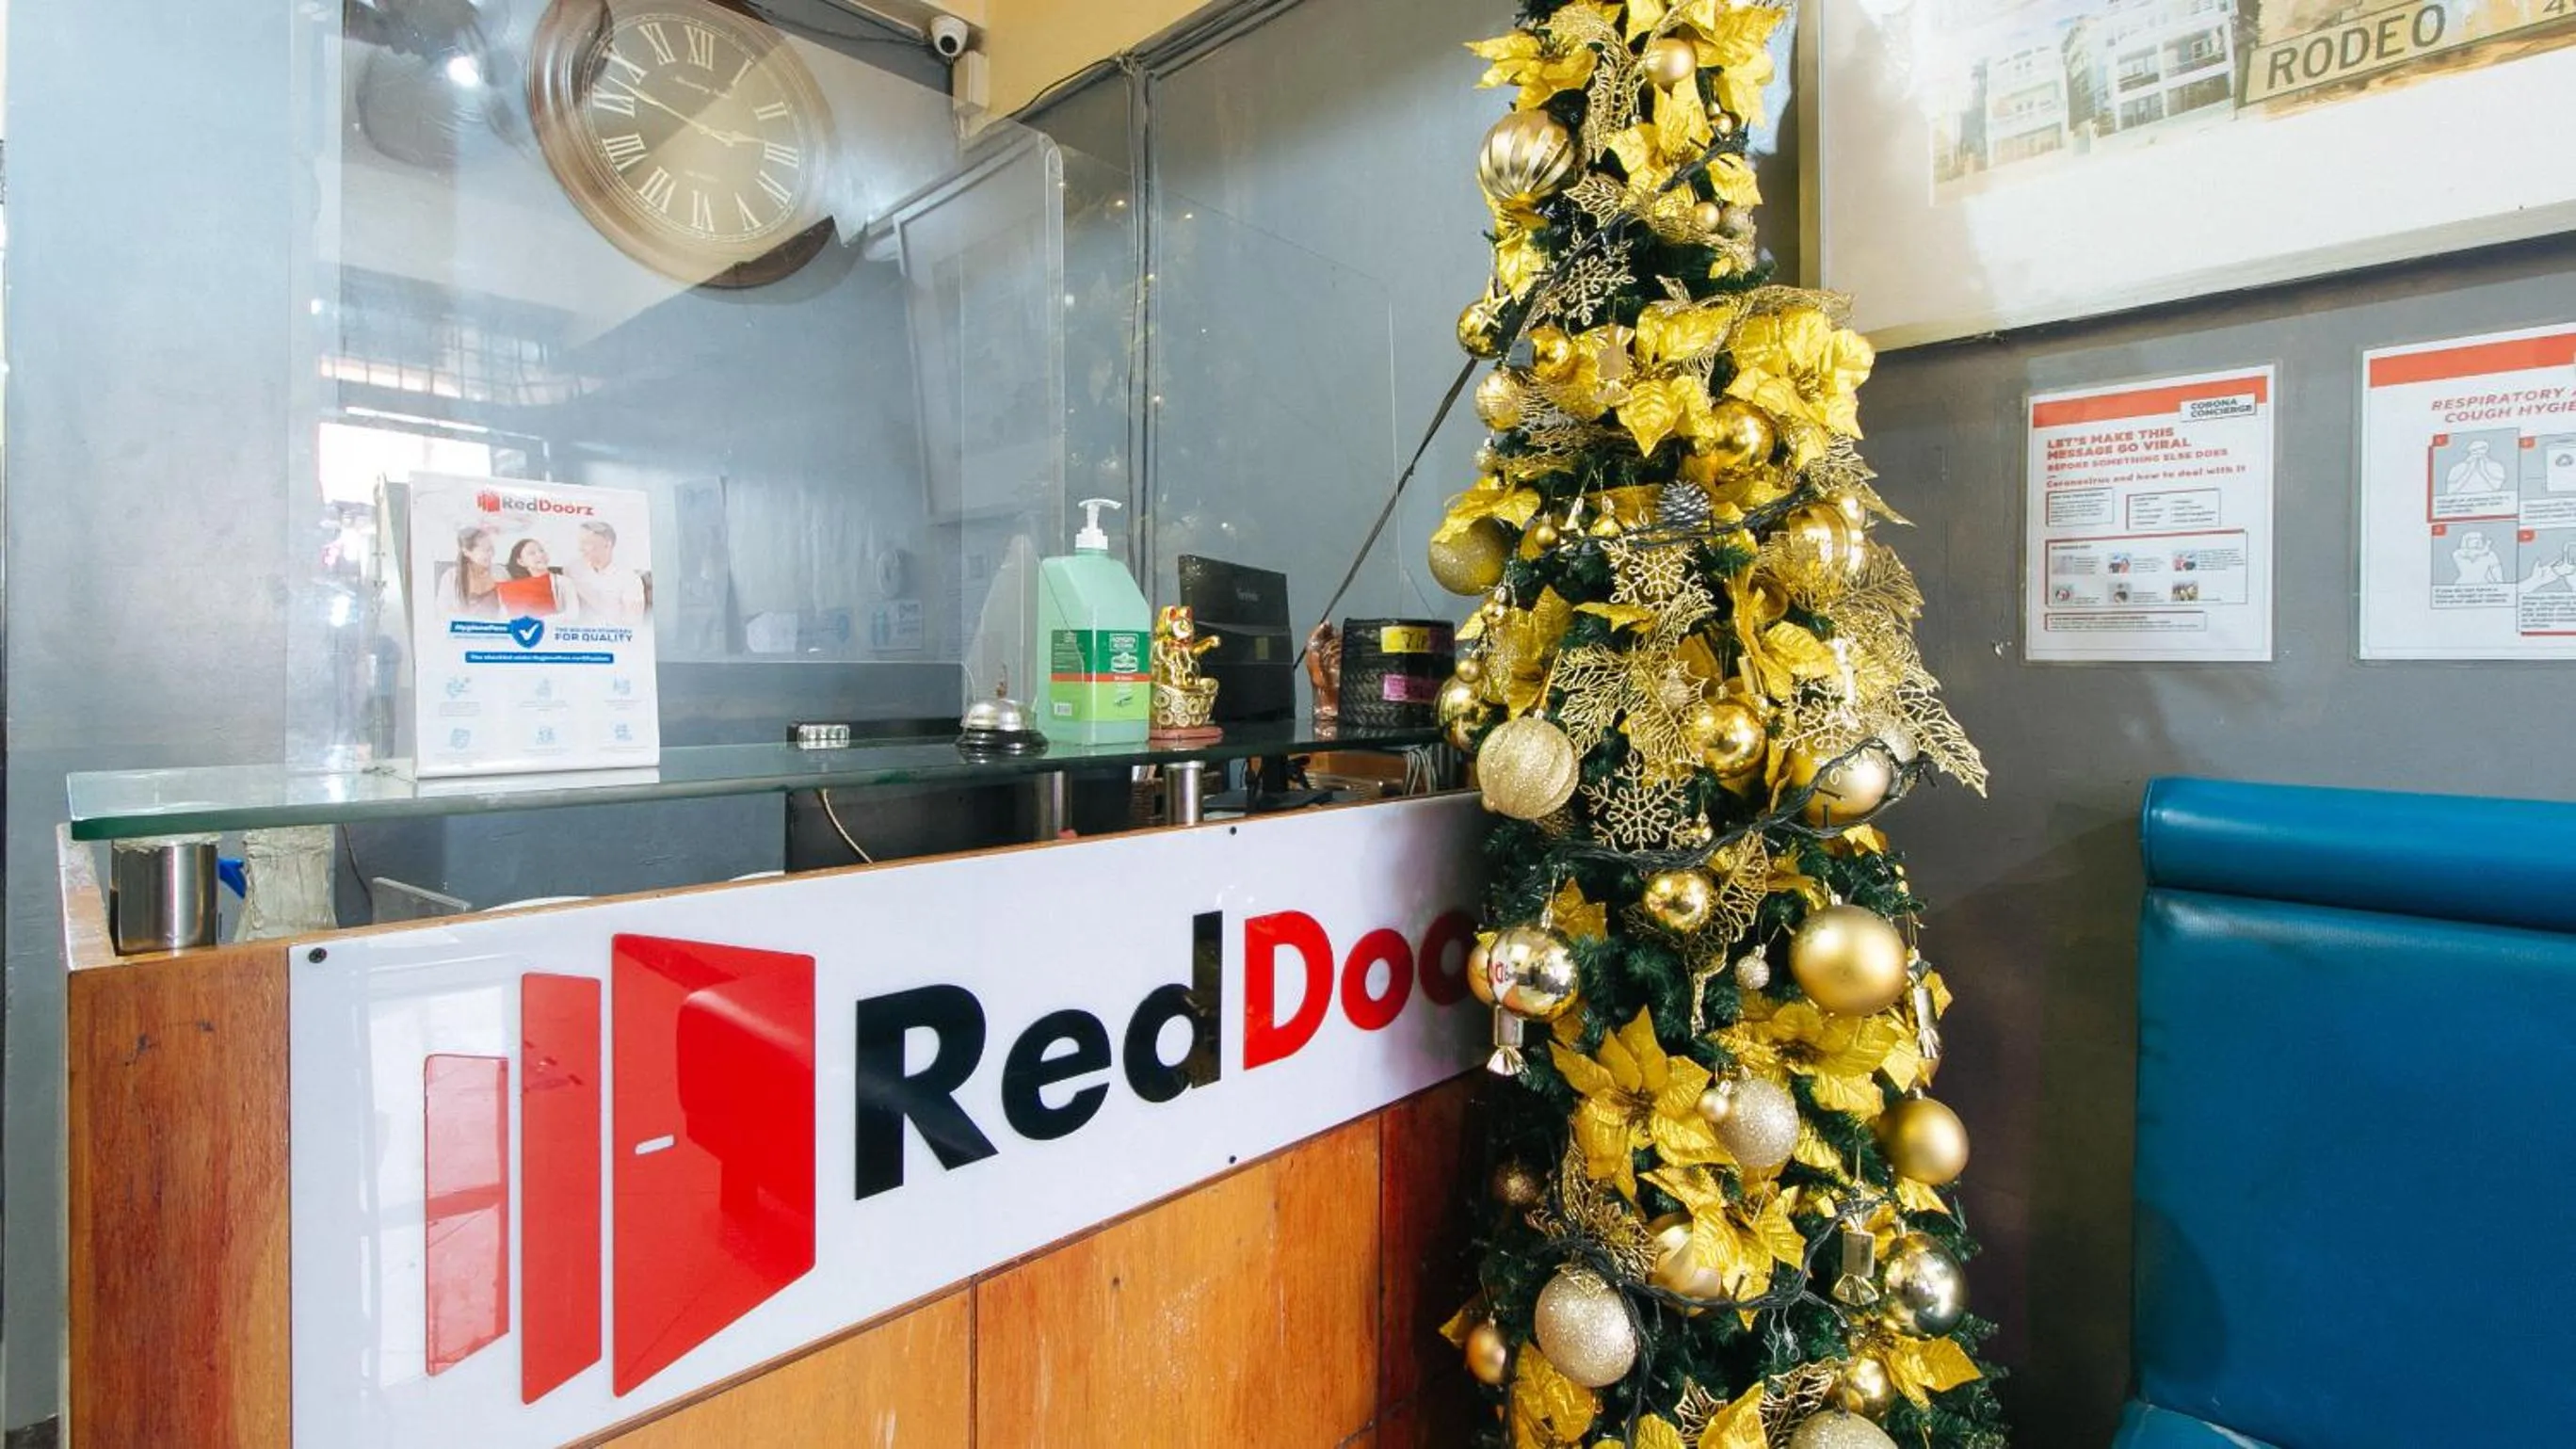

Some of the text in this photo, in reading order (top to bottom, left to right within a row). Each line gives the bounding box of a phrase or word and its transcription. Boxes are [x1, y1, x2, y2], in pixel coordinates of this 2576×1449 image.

[637, 22, 677, 66] XI
[683, 24, 716, 72] XII
[2267, 4, 2445, 89] RODEO
[753, 101, 789, 121] II
[764, 141, 800, 169] III
[636, 166, 677, 215] VII
[690, 189, 716, 233] VI
[733, 191, 763, 232] V
[2431, 387, 2567, 411] RESPIRATORY
[2444, 407, 2512, 423] COUGH
[2091, 430, 2133, 443] MAKE
[2137, 427, 2174, 440] THIS
[2047, 437, 2192, 460] MESSAGE GO VIRAL
[2092, 455, 2160, 467] SOMETHING
[2163, 452, 2193, 461] ELSE
[2196, 447, 2229, 459] DOES
[2113, 474, 2133, 482] and
[502, 496, 594, 516] RedDoorz
[554, 633, 633, 642] FOR QUALITY
